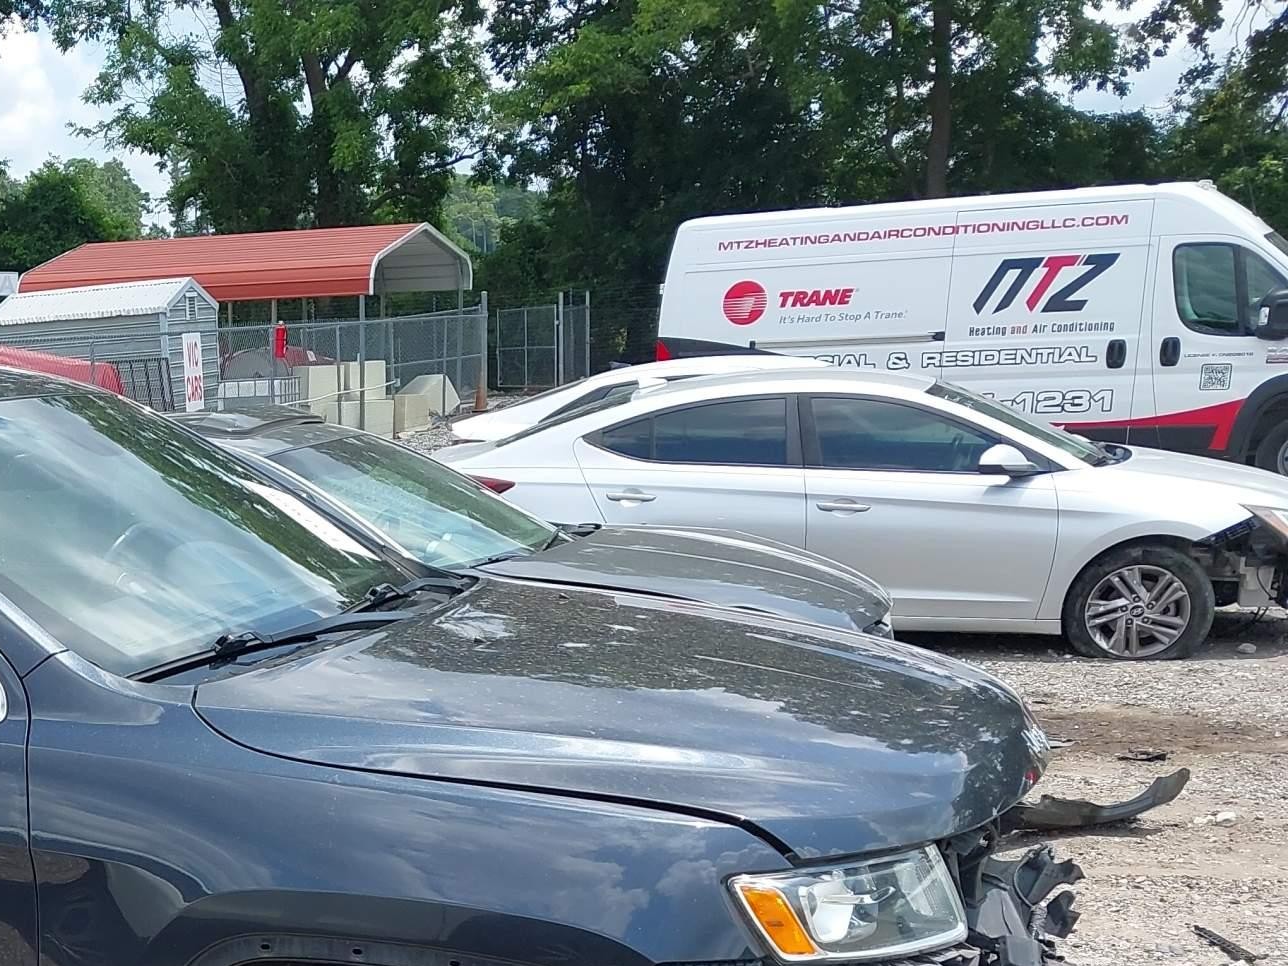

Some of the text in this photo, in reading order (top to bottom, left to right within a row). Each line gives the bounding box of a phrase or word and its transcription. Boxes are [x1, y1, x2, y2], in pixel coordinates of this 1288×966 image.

[718, 214, 1129, 252] MTZHEATINGANDAIRCONDITIONINGLLC.COM
[972, 252, 1121, 315] MTZ
[779, 288, 855, 308] TRANE
[779, 314, 794, 324] It's
[797, 313, 822, 323] Hard
[824, 313, 836, 322] To
[838, 312, 862, 323] Stop
[863, 311, 871, 320] A
[968, 321, 1115, 337] Heating and Air Conditioning
[186, 341, 199, 368] VIC
[886, 352, 910, 370] &
[921, 346, 1098, 368] RESIDENTIAL
[186, 375, 202, 402] CARS
